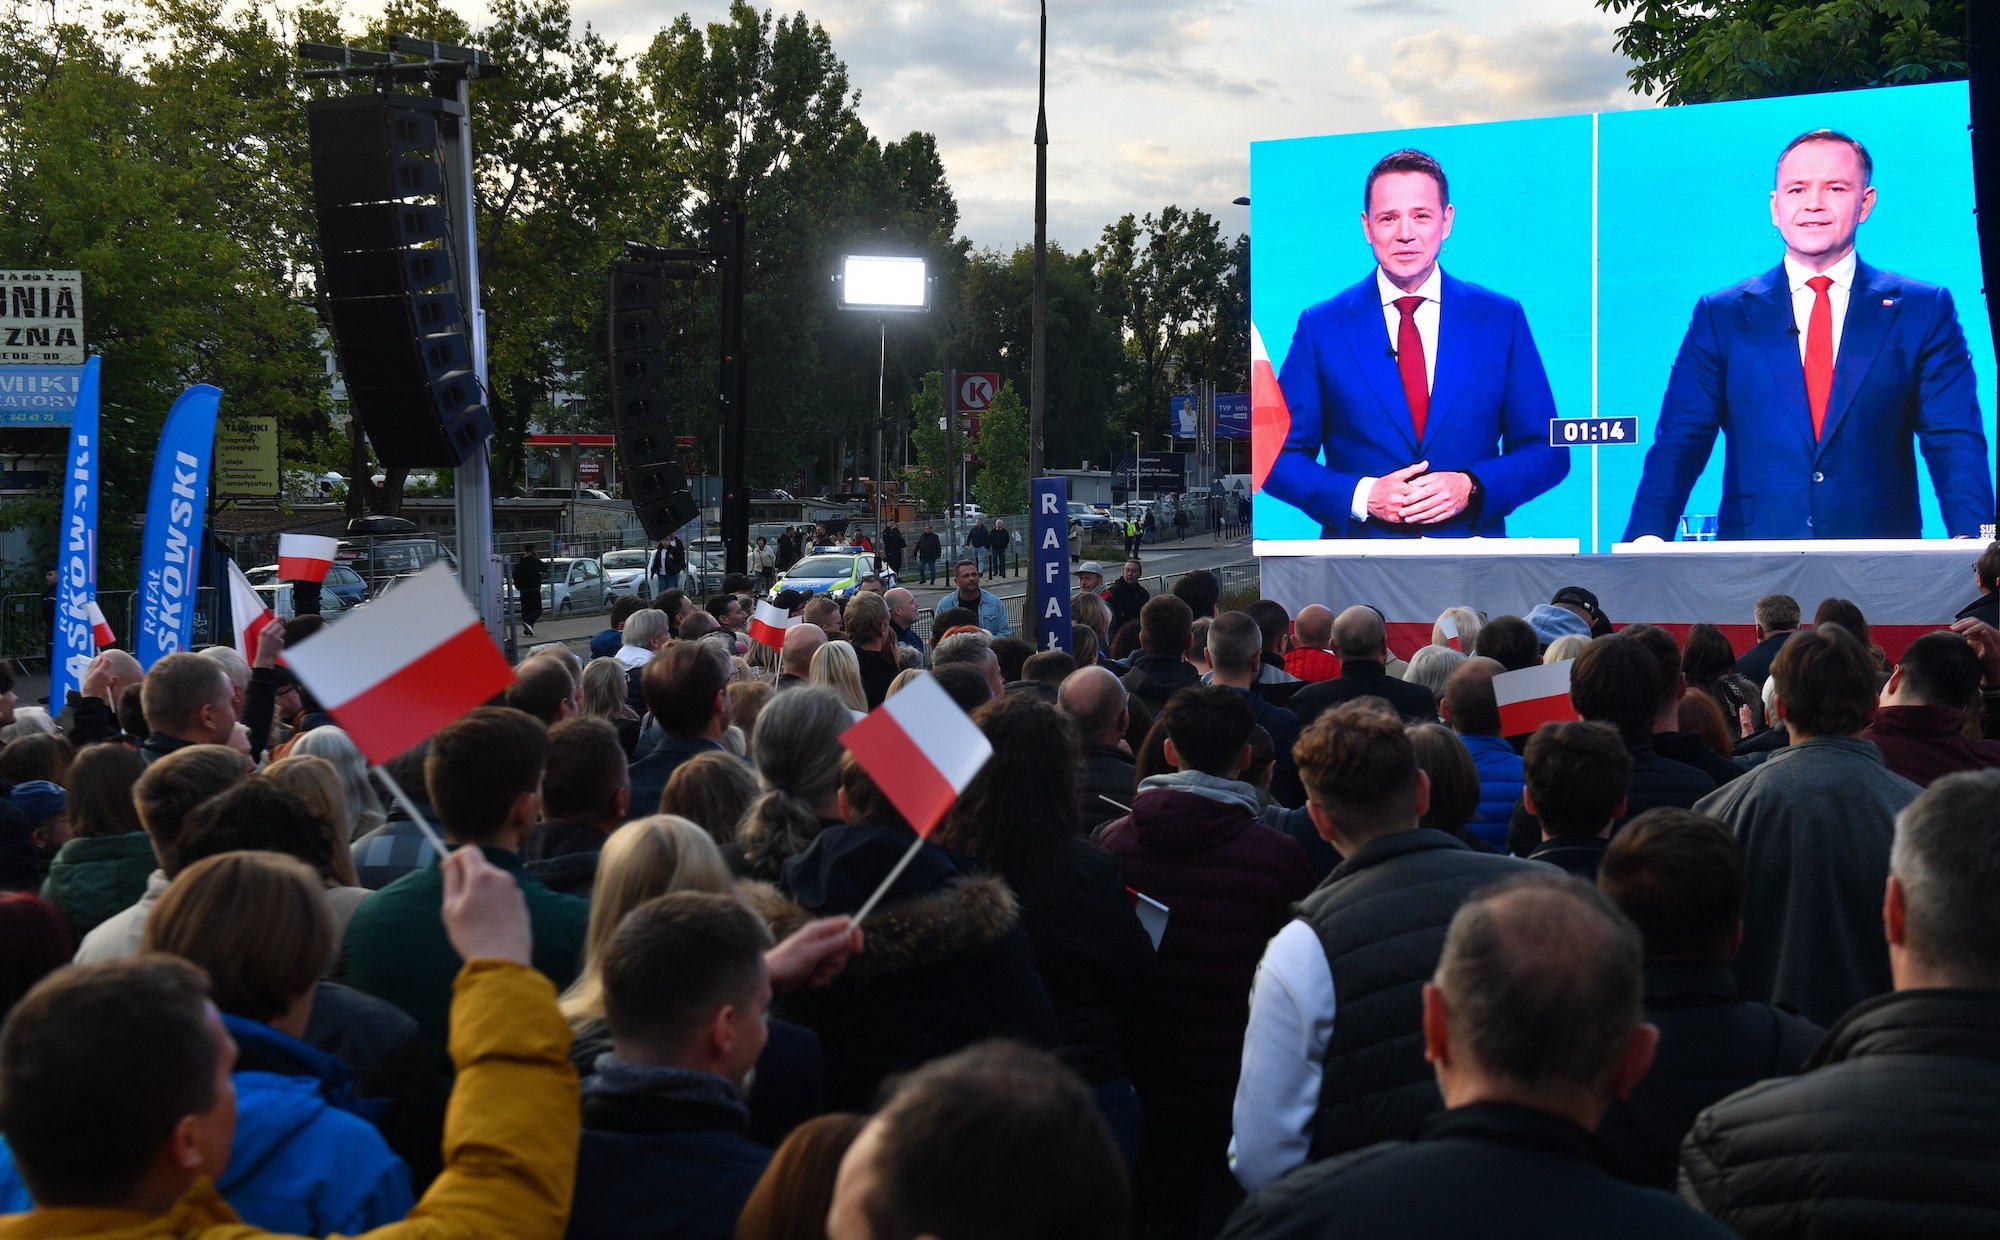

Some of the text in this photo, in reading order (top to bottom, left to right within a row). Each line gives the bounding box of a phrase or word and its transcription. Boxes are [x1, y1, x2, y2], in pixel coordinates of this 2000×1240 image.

[969, 382, 991, 404] K
[1219, 403, 1248, 412] TVP info
[1564, 421, 1625, 441] 01:14
[157, 450, 198, 655] SKOWSKI
[1041, 493, 1063, 651] RAFAŁ
[144, 568, 161, 635] RAFAŁ
